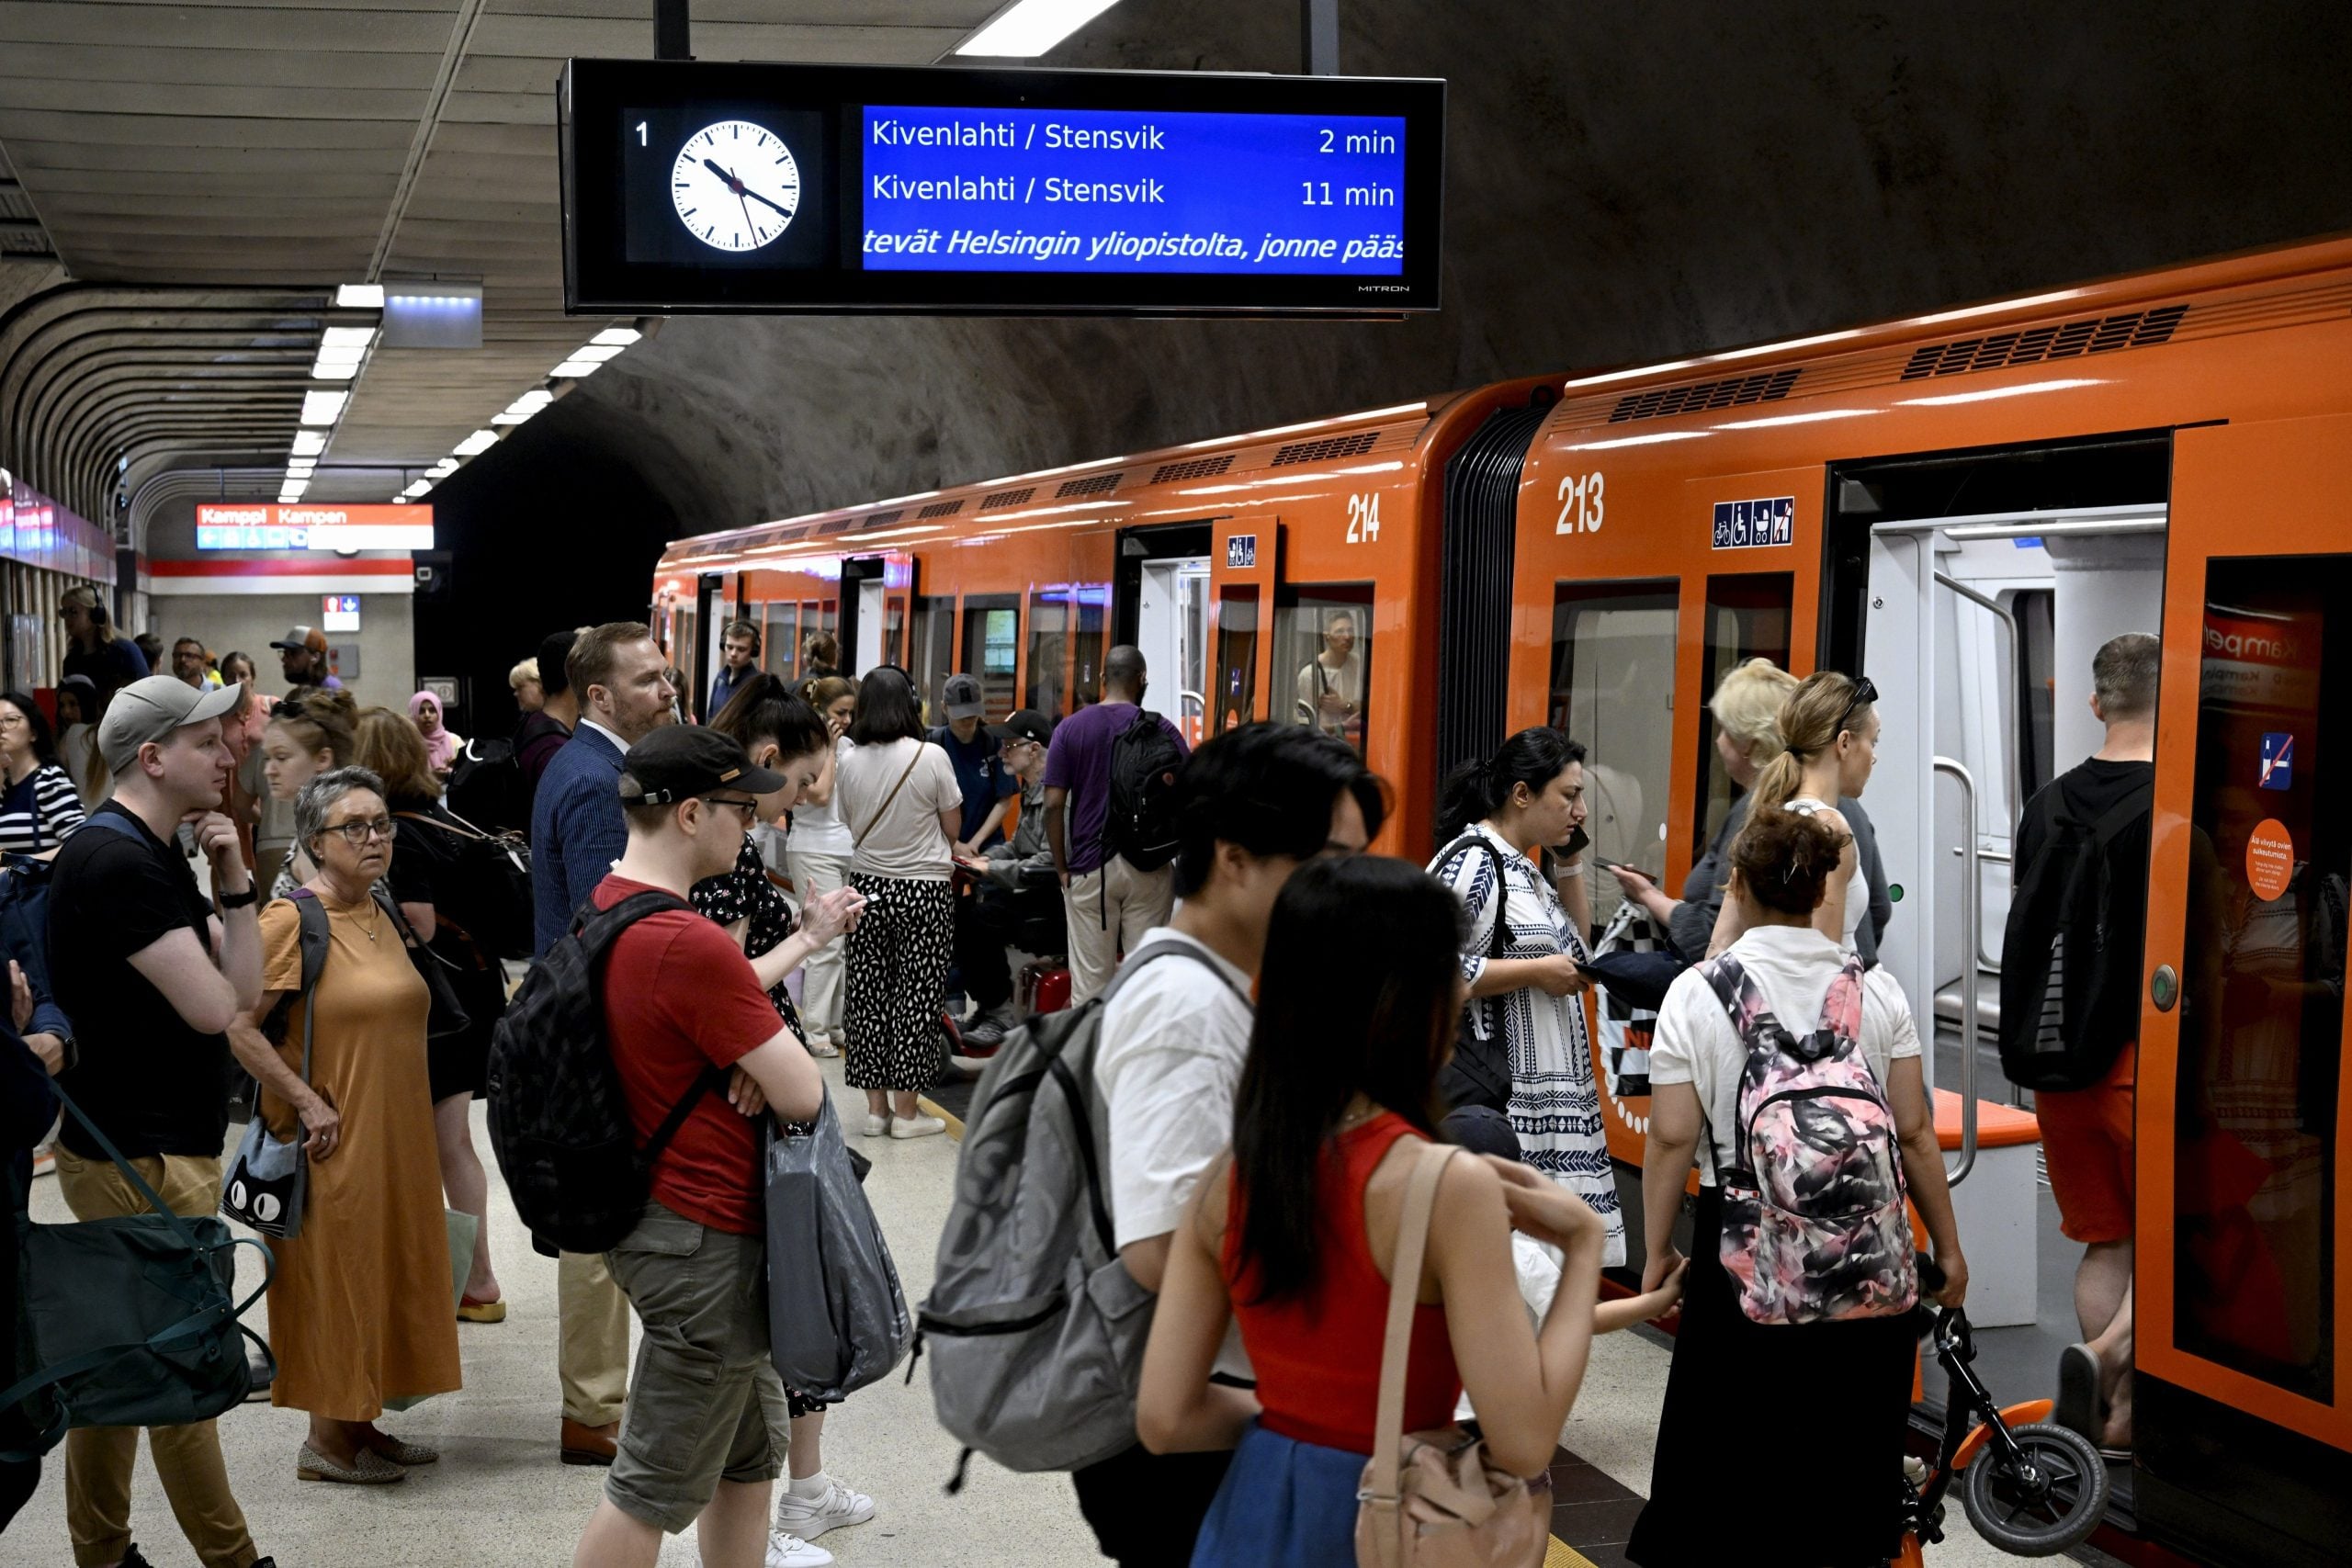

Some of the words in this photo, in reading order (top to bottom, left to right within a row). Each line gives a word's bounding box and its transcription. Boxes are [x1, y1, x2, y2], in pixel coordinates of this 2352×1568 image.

[636, 120, 647, 147] 1
[874, 120, 1013, 146] Kivenlahti
[1046, 124, 1164, 149] Stensvik
[1320, 130, 1333, 152] 2
[1347, 130, 1394, 153] min
[875, 175, 1013, 200] Kivenlahti
[1046, 178, 1164, 202] Stensvik
[1303, 182, 1332, 205] 11
[1346, 183, 1393, 206] min
[864, 229, 942, 253] tevät
[947, 230, 1080, 260] Helsingin
[1086, 231, 1248, 261] yliopistolta,
[1254, 233, 1337, 262] jonne
[201, 508, 267, 525] Kamppi
[278, 508, 347, 525] Kampen
[1556, 472, 1603, 535] 213
[1347, 493, 1379, 543] 214
